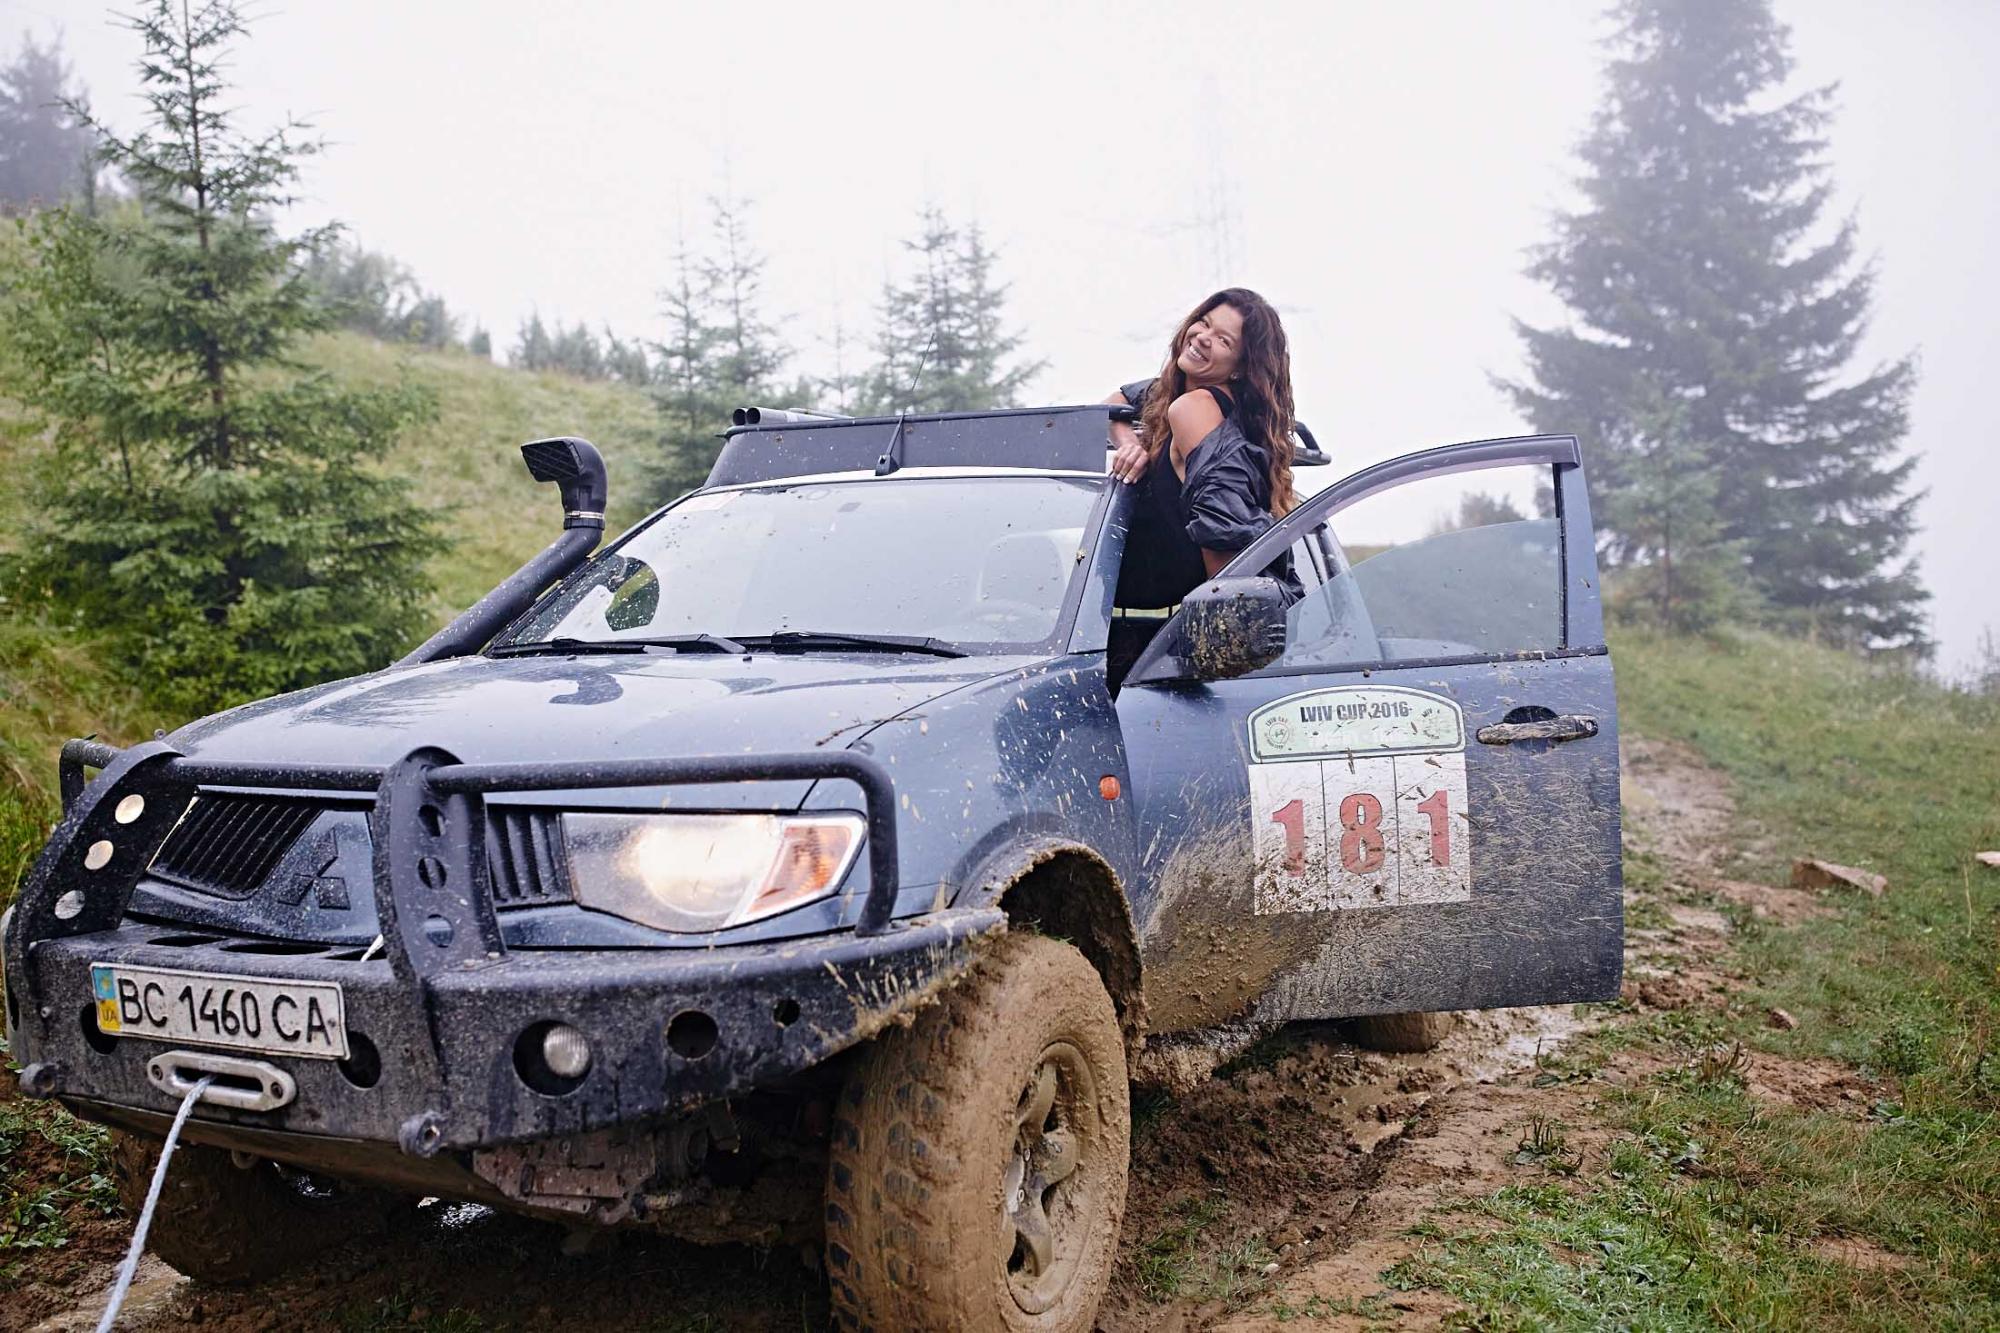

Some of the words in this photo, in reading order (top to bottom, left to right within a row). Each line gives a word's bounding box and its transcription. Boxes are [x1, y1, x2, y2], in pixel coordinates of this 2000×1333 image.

[1300, 705, 1333, 723] LVIV
[1337, 703, 1367, 720] CUP
[1371, 701, 1409, 718] 2016
[1272, 790, 1450, 877] 181
[102, 1009, 118, 1022] UA
[117, 977, 167, 1028] BC
[178, 985, 261, 1039] 1460
[271, 994, 331, 1046] CA
